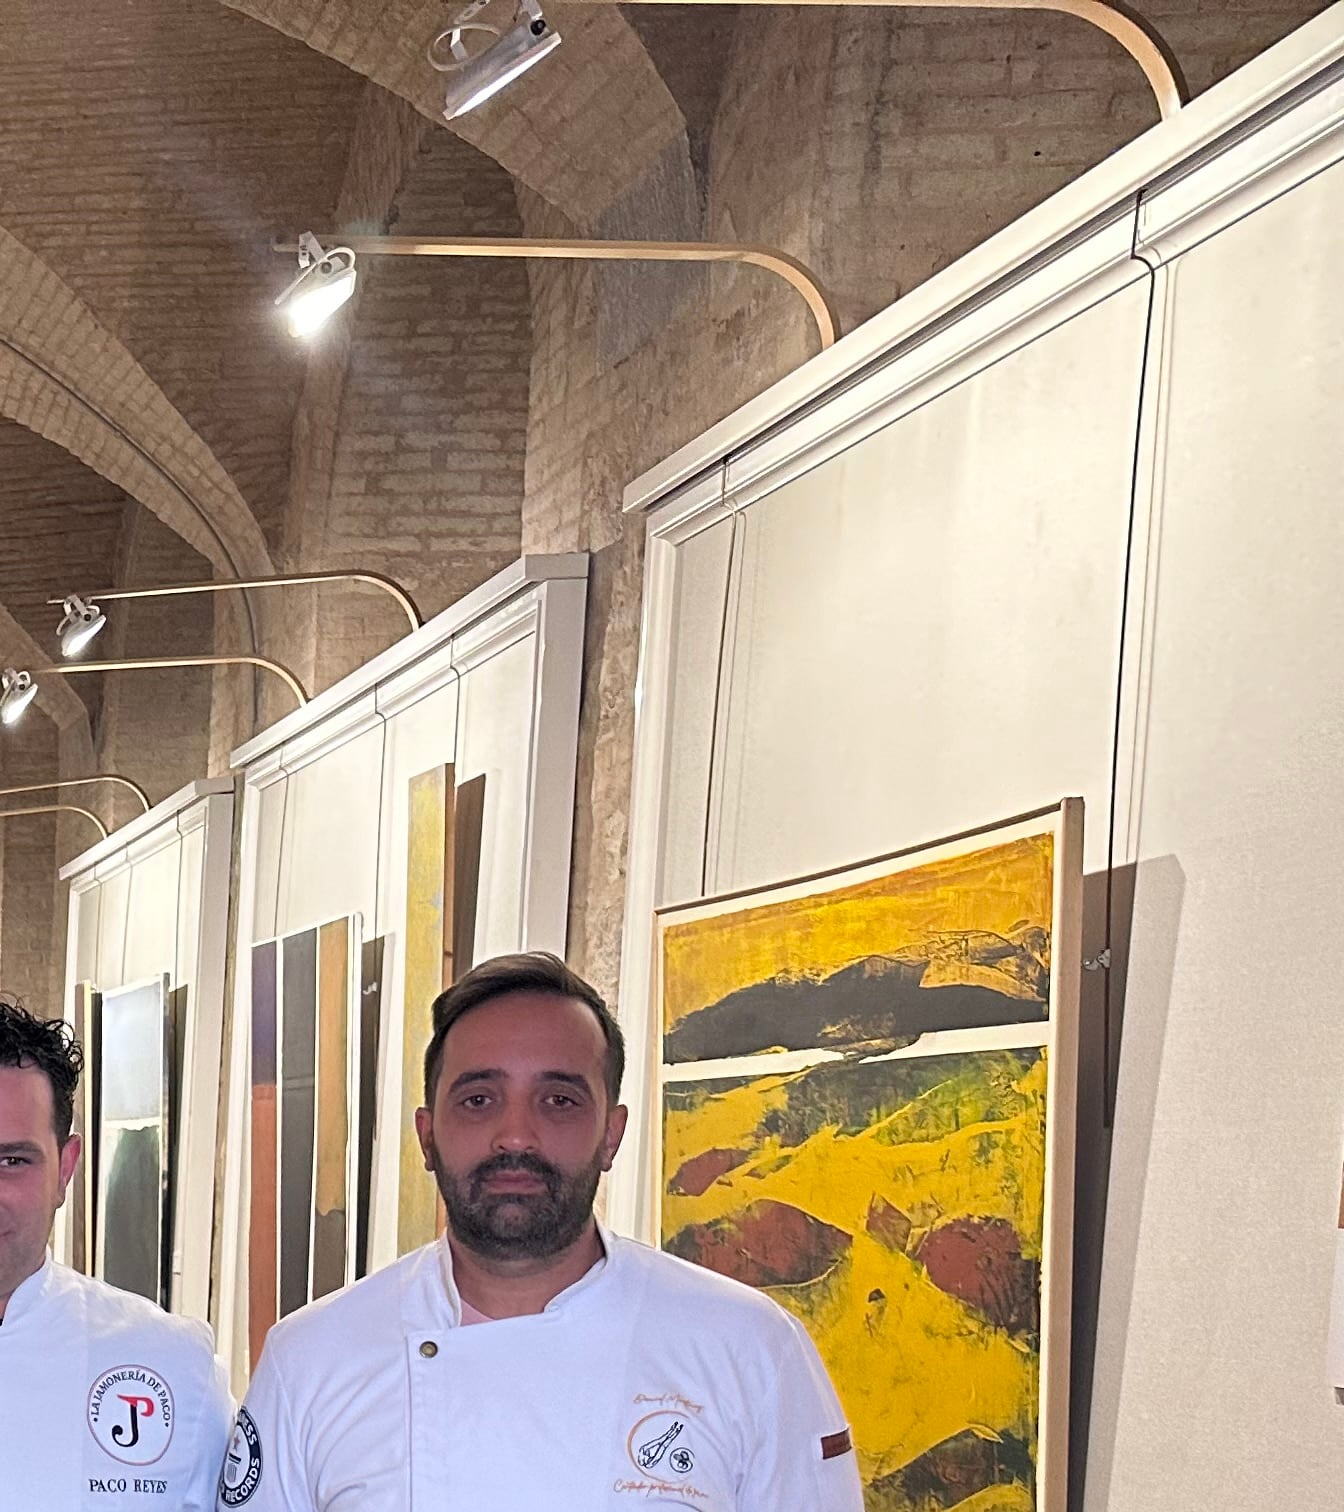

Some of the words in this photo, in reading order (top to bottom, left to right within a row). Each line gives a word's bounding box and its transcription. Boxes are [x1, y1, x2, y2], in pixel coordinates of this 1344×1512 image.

[91, 1402, 100, 1416] LA
[146, 1377, 162, 1392] DE
[158, 1389, 171, 1422] PACO
[88, 1478, 127, 1493] PACO
[133, 1478, 168, 1494] REYES
[225, 1457, 260, 1503] RECORDS
